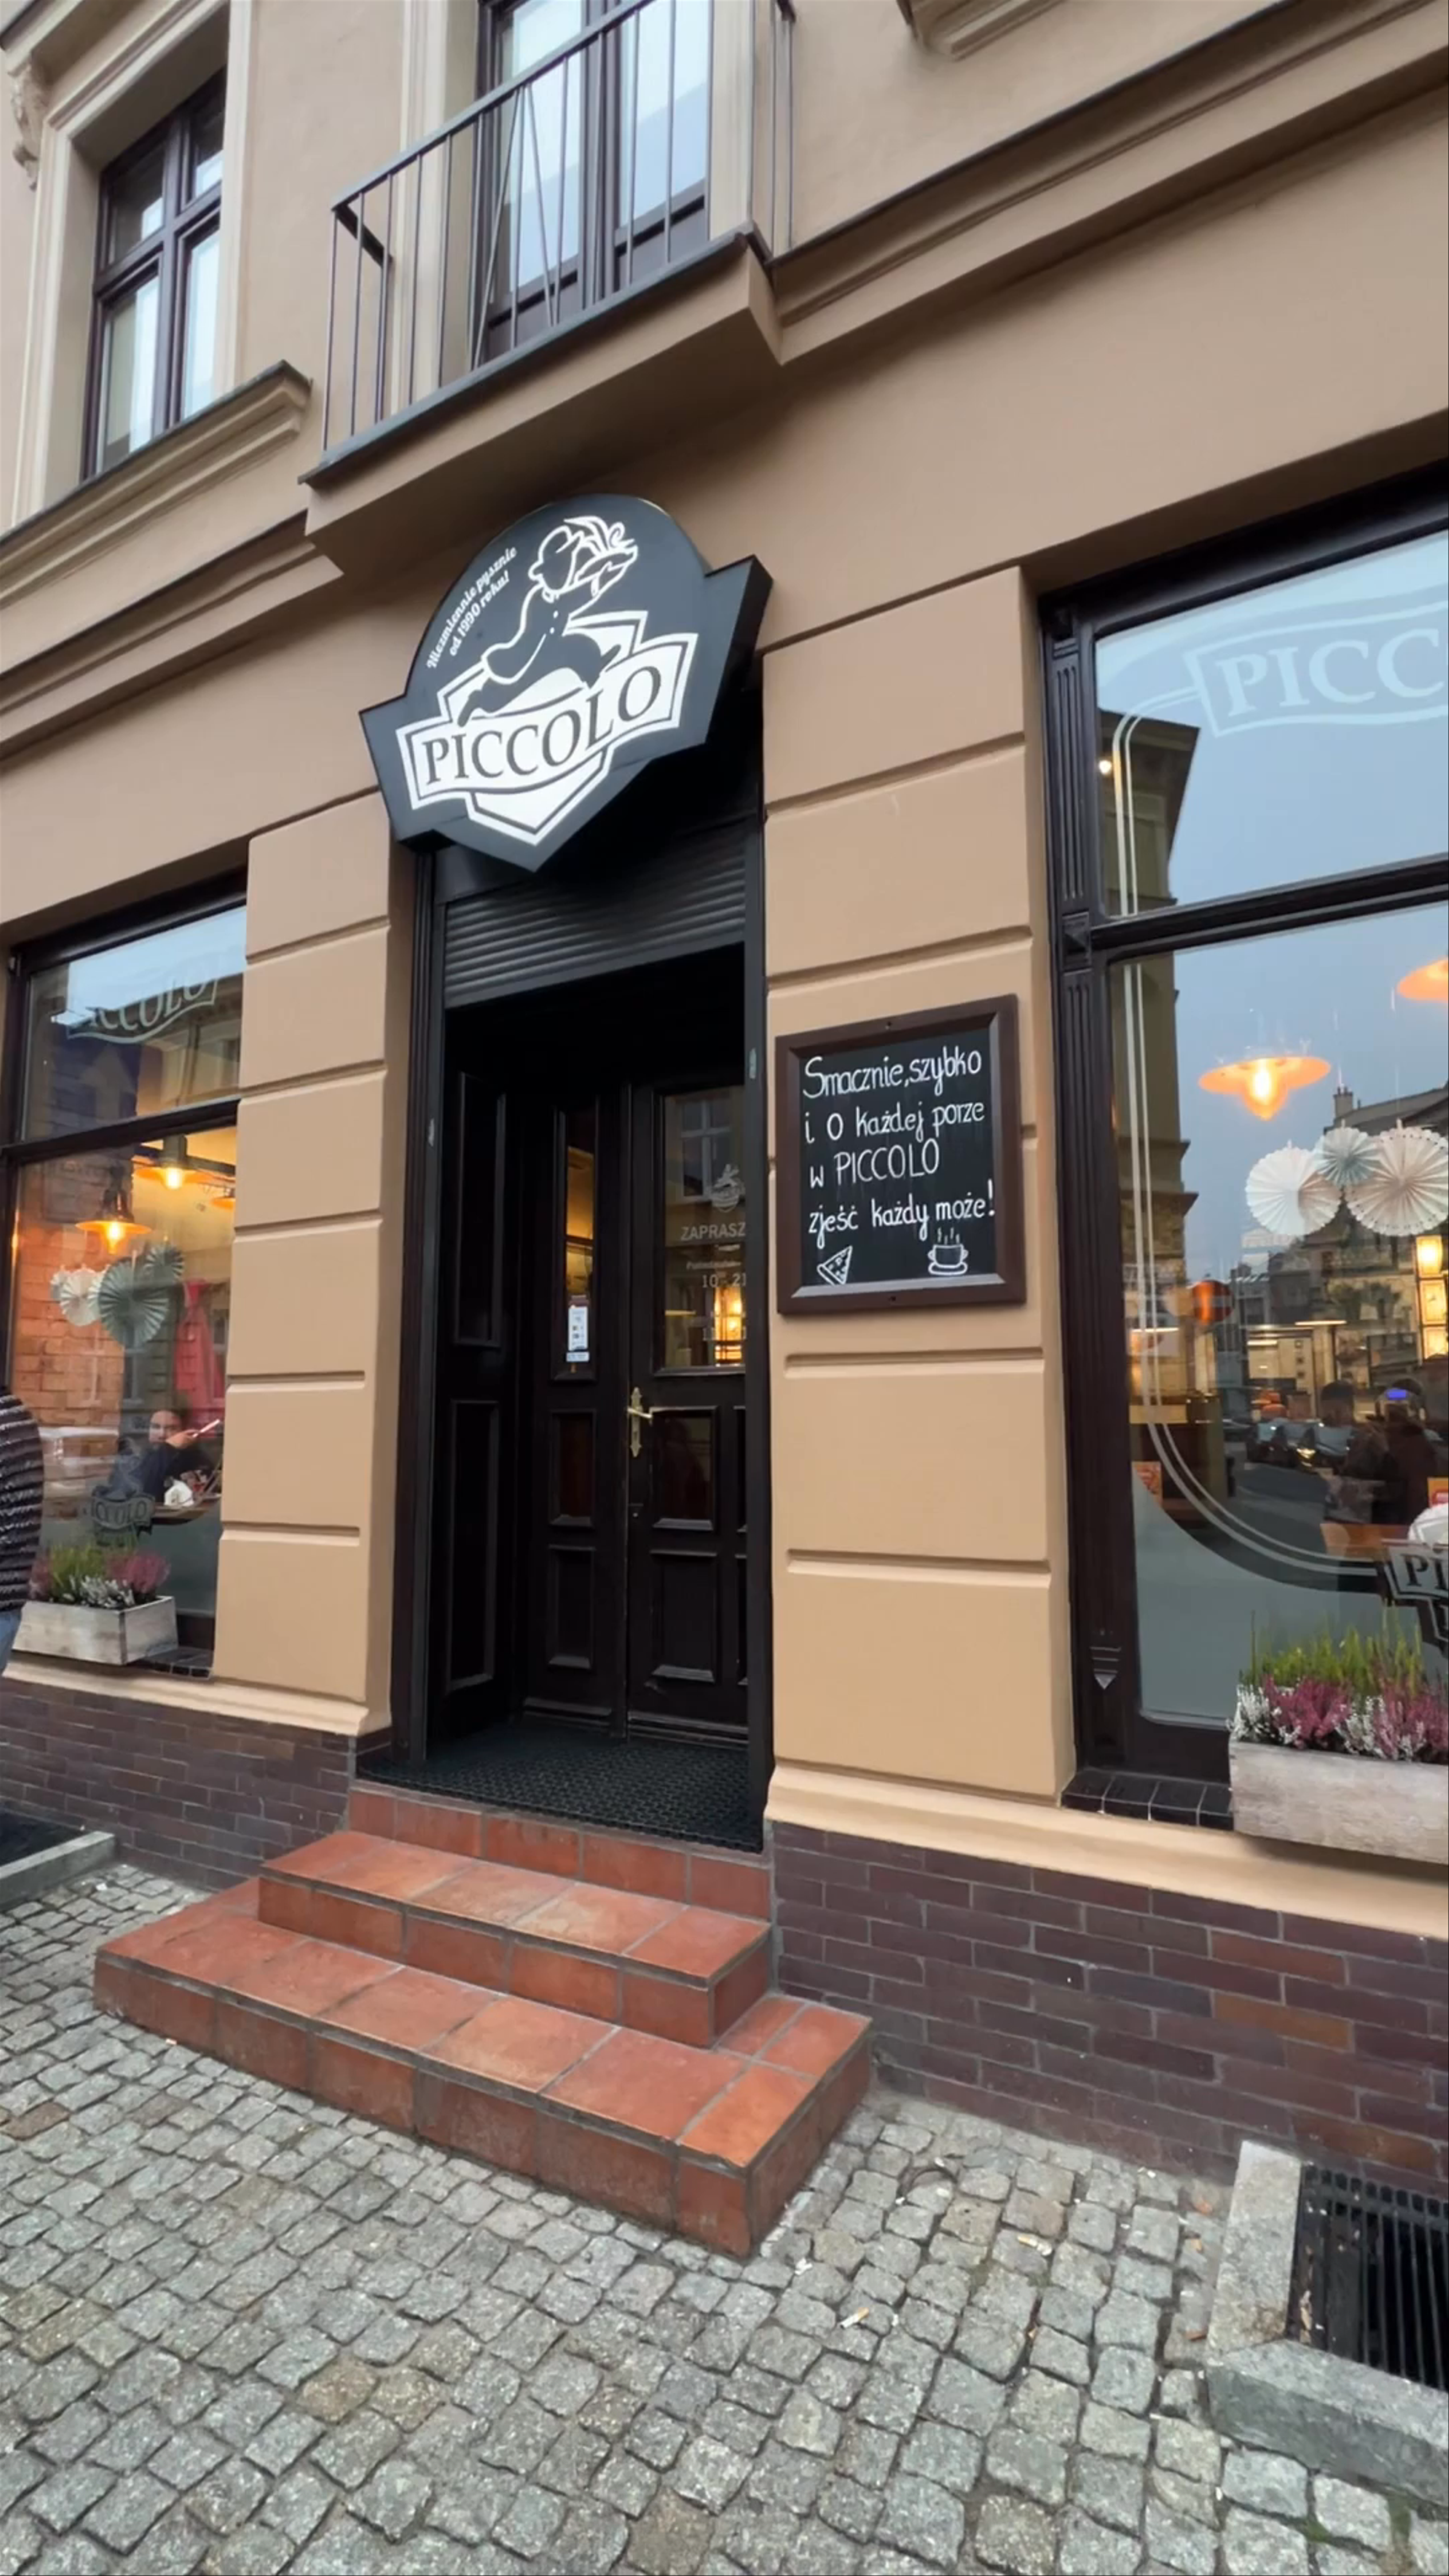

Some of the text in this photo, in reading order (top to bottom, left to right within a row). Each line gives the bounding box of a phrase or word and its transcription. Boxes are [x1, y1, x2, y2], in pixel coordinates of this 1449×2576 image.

[476, 547, 517, 593] pysznie
[450, 570, 509, 656] od 1990 roku!
[422, 665, 662, 786] PICCOLO
[804, 1112, 815, 1144] i
[856, 1101, 924, 1143] każdej
[932, 1101, 984, 1137] porze
[834, 1138, 940, 1186] PICCOLO
[808, 1179, 995, 1249] zjeść każdy może!
